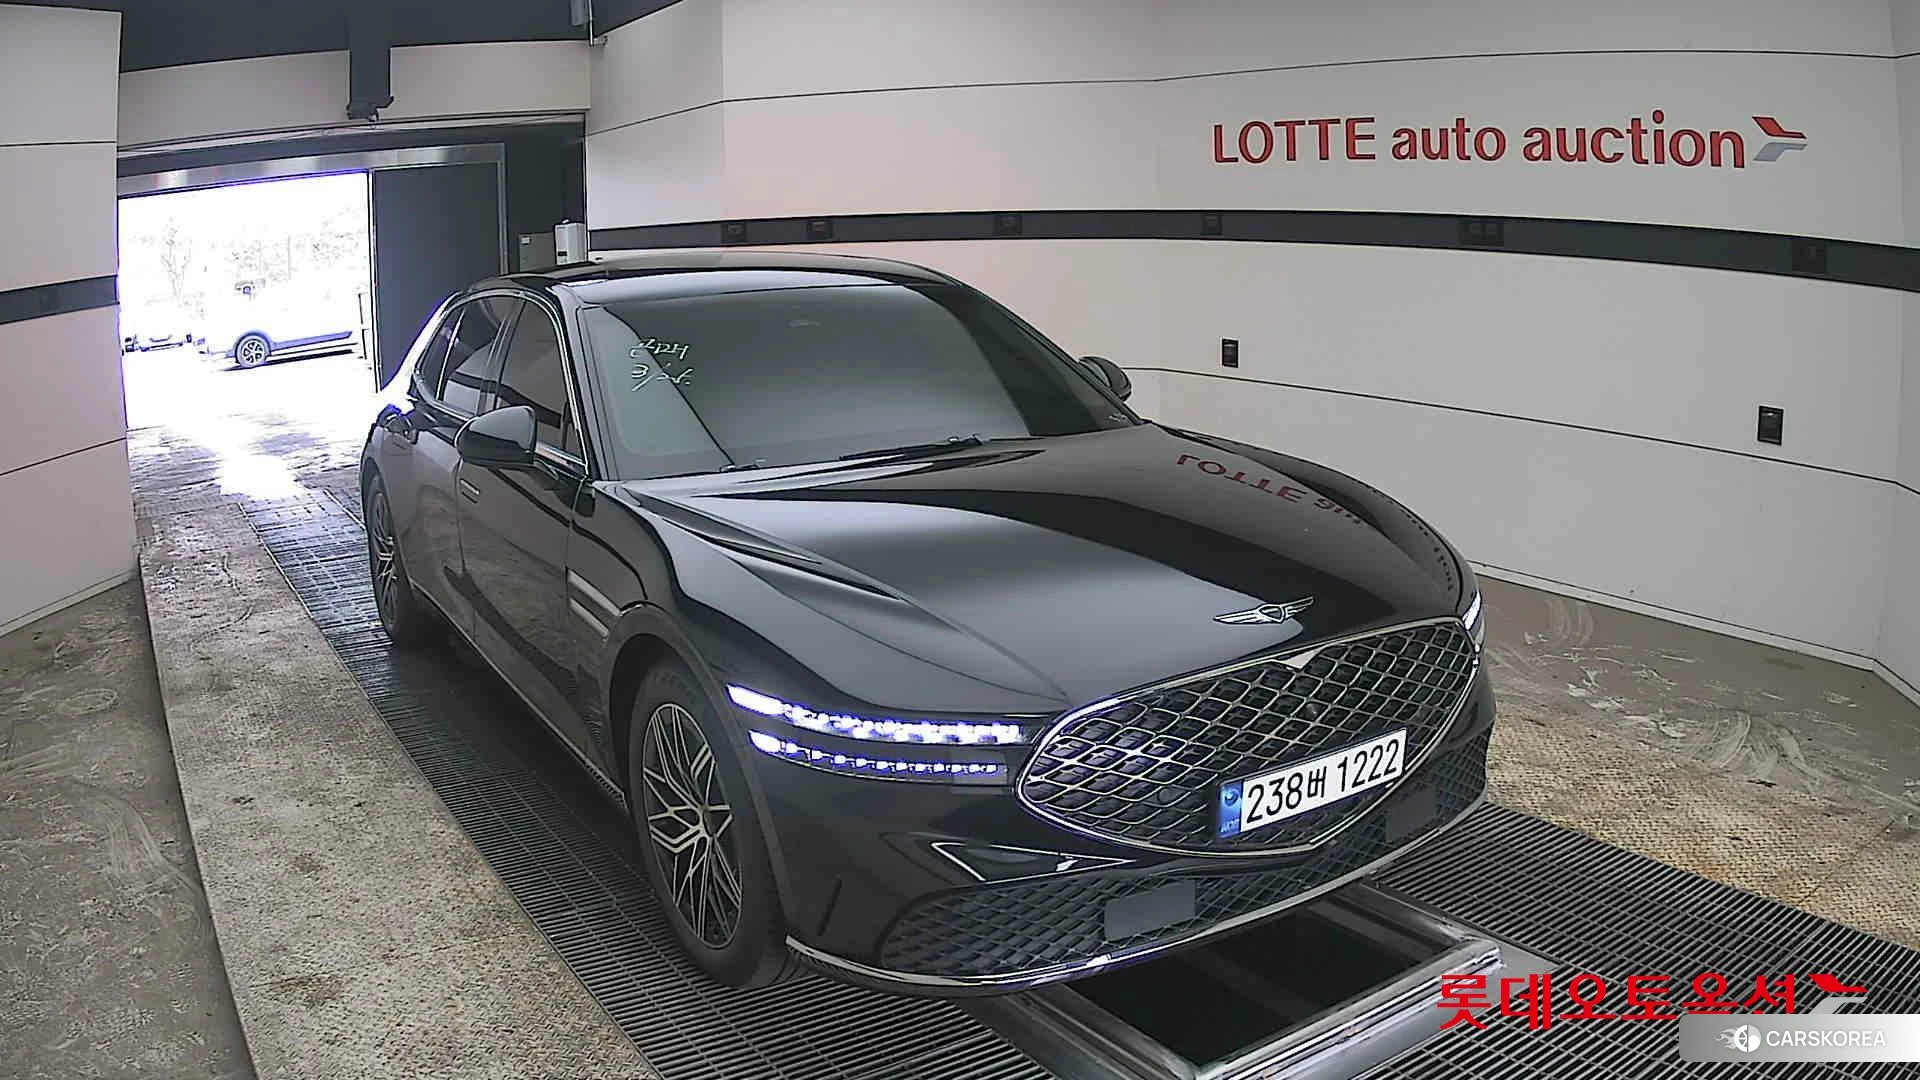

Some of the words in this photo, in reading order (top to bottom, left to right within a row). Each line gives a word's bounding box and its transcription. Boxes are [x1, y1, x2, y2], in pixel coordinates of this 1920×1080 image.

[1213, 116, 1376, 164] LOTTE
[1391, 116, 1507, 161] auto
[1522, 109, 1746, 169] auction
[1246, 766, 1327, 824] 238버
[1337, 738, 1400, 792] 1222
